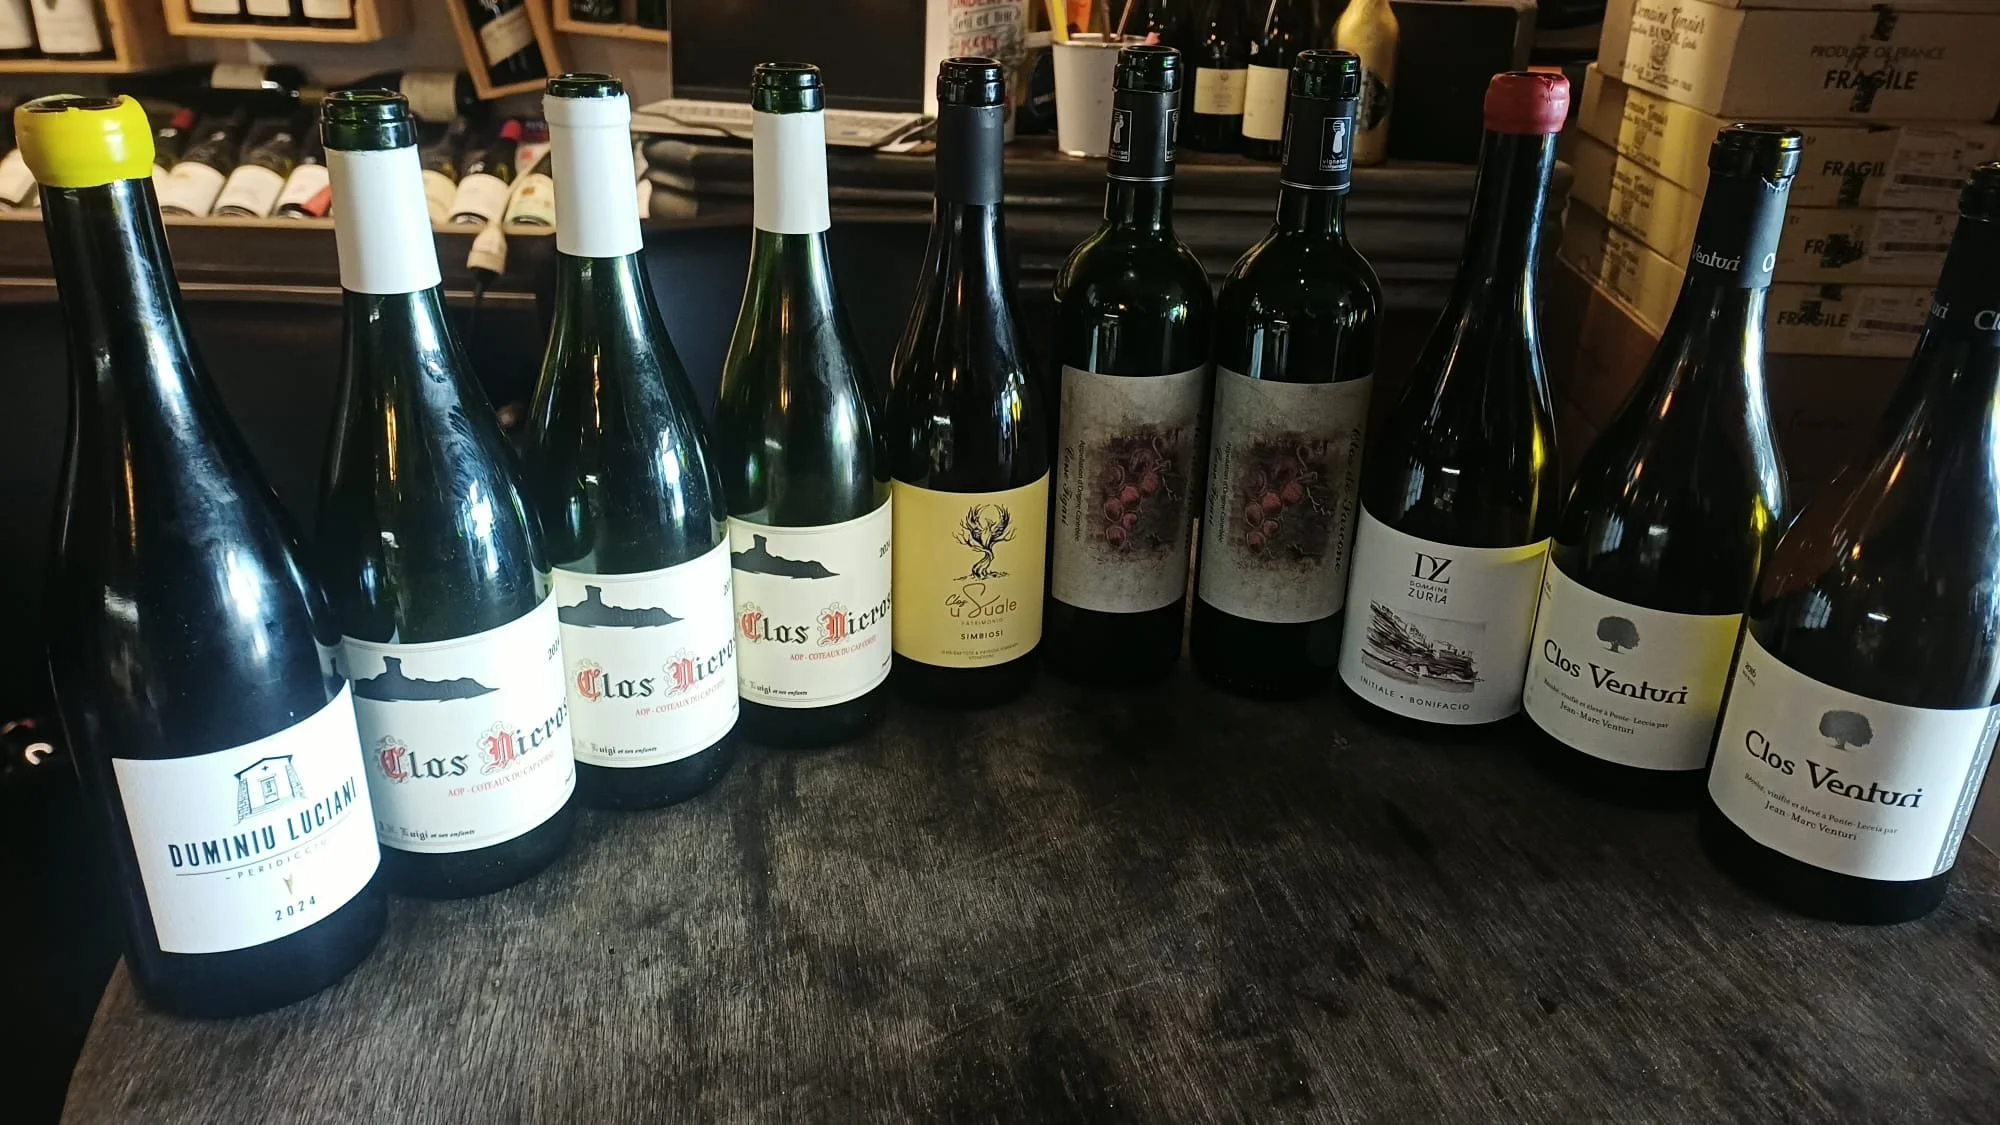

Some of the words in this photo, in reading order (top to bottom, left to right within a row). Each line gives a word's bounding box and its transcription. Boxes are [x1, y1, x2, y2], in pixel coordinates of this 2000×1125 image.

[1895, 46, 1947, 60] FRANCE
[1824, 70, 1919, 90] FRAGILE
[1822, 161, 1885, 177] FRAGIL
[1411, 552, 1452, 584] DZ
[1408, 588, 1448, 605] ZURIA
[1409, 580, 1448, 594] DOMAINE
[962, 582, 1017, 619] Suale
[740, 610, 810, 644] Clos
[823, 592, 891, 642] Nicros
[961, 618, 1004, 626] PATRIMONIO
[960, 629, 1003, 640] SIMBIOSI
[789, 653, 804, 661] AOP
[808, 649, 841, 661] COTEAUX
[842, 647, 850, 655] DU
[576, 666, 655, 703] Clos
[670, 633, 736, 693] Nicro
[1544, 639, 1581, 678] Clos
[1588, 662, 1688, 705] Venturi
[1360, 675, 1395, 698] INITIALE
[1410, 697, 1470, 711] BONIFACIO
[635, 708, 650, 717] AOP
[655, 699, 690, 714] COTEAUX
[1602, 719, 1634, 735] Venturi
[379, 745, 469, 783] Clos
[488, 697, 568, 770] Nicros
[1745, 729, 1796, 776] Clos
[1805, 759, 1923, 809] Venturi
[448, 788, 465, 797] AOP
[471, 775, 511, 794] COTEAUX
[168, 825, 275, 868] DUMINIU
[286, 776, 357, 841] LUCIANI
[1818, 823, 1857, 841] Venturi
[274, 895, 316, 921] 2024
